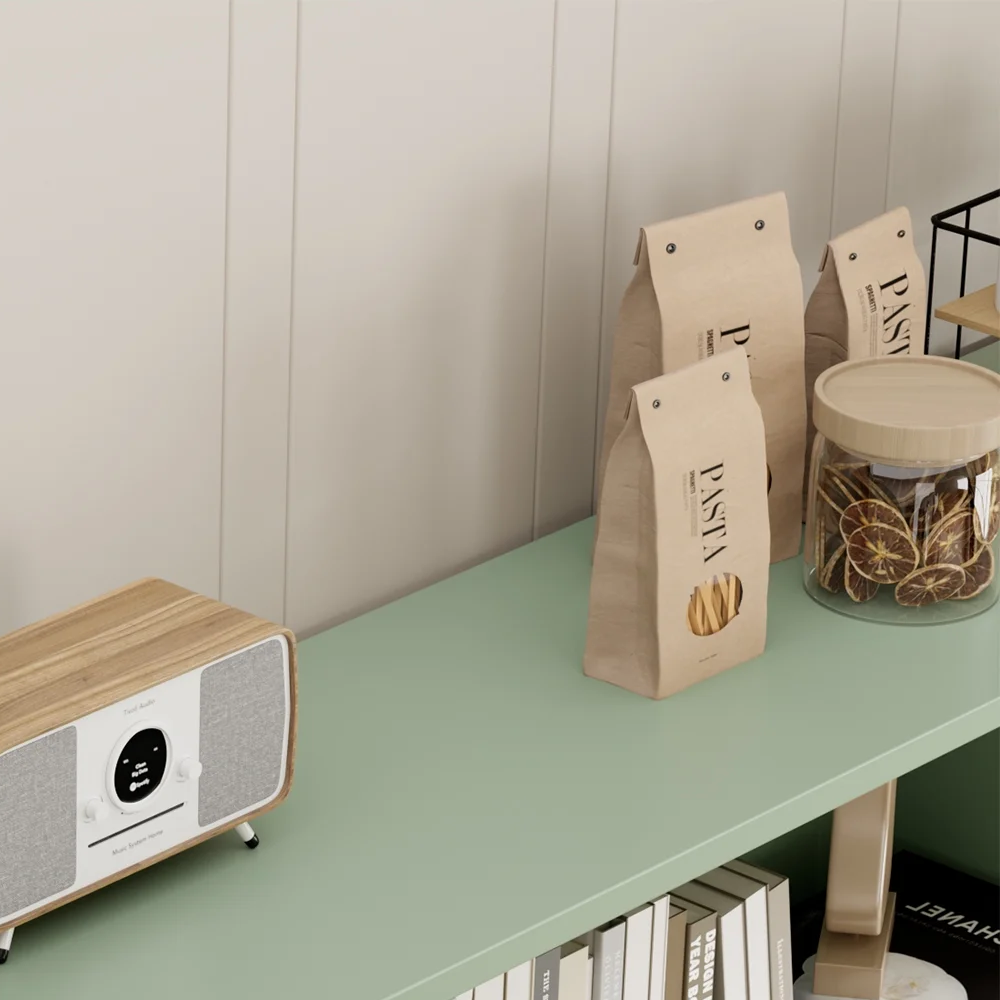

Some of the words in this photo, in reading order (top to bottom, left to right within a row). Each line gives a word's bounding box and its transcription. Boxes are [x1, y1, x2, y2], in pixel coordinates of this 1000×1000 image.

[699, 462, 729, 564] PASTA
[542, 969, 550, 993] THE
[688, 934, 702, 982] YEAR
[702, 928, 717, 993] DESIGN
